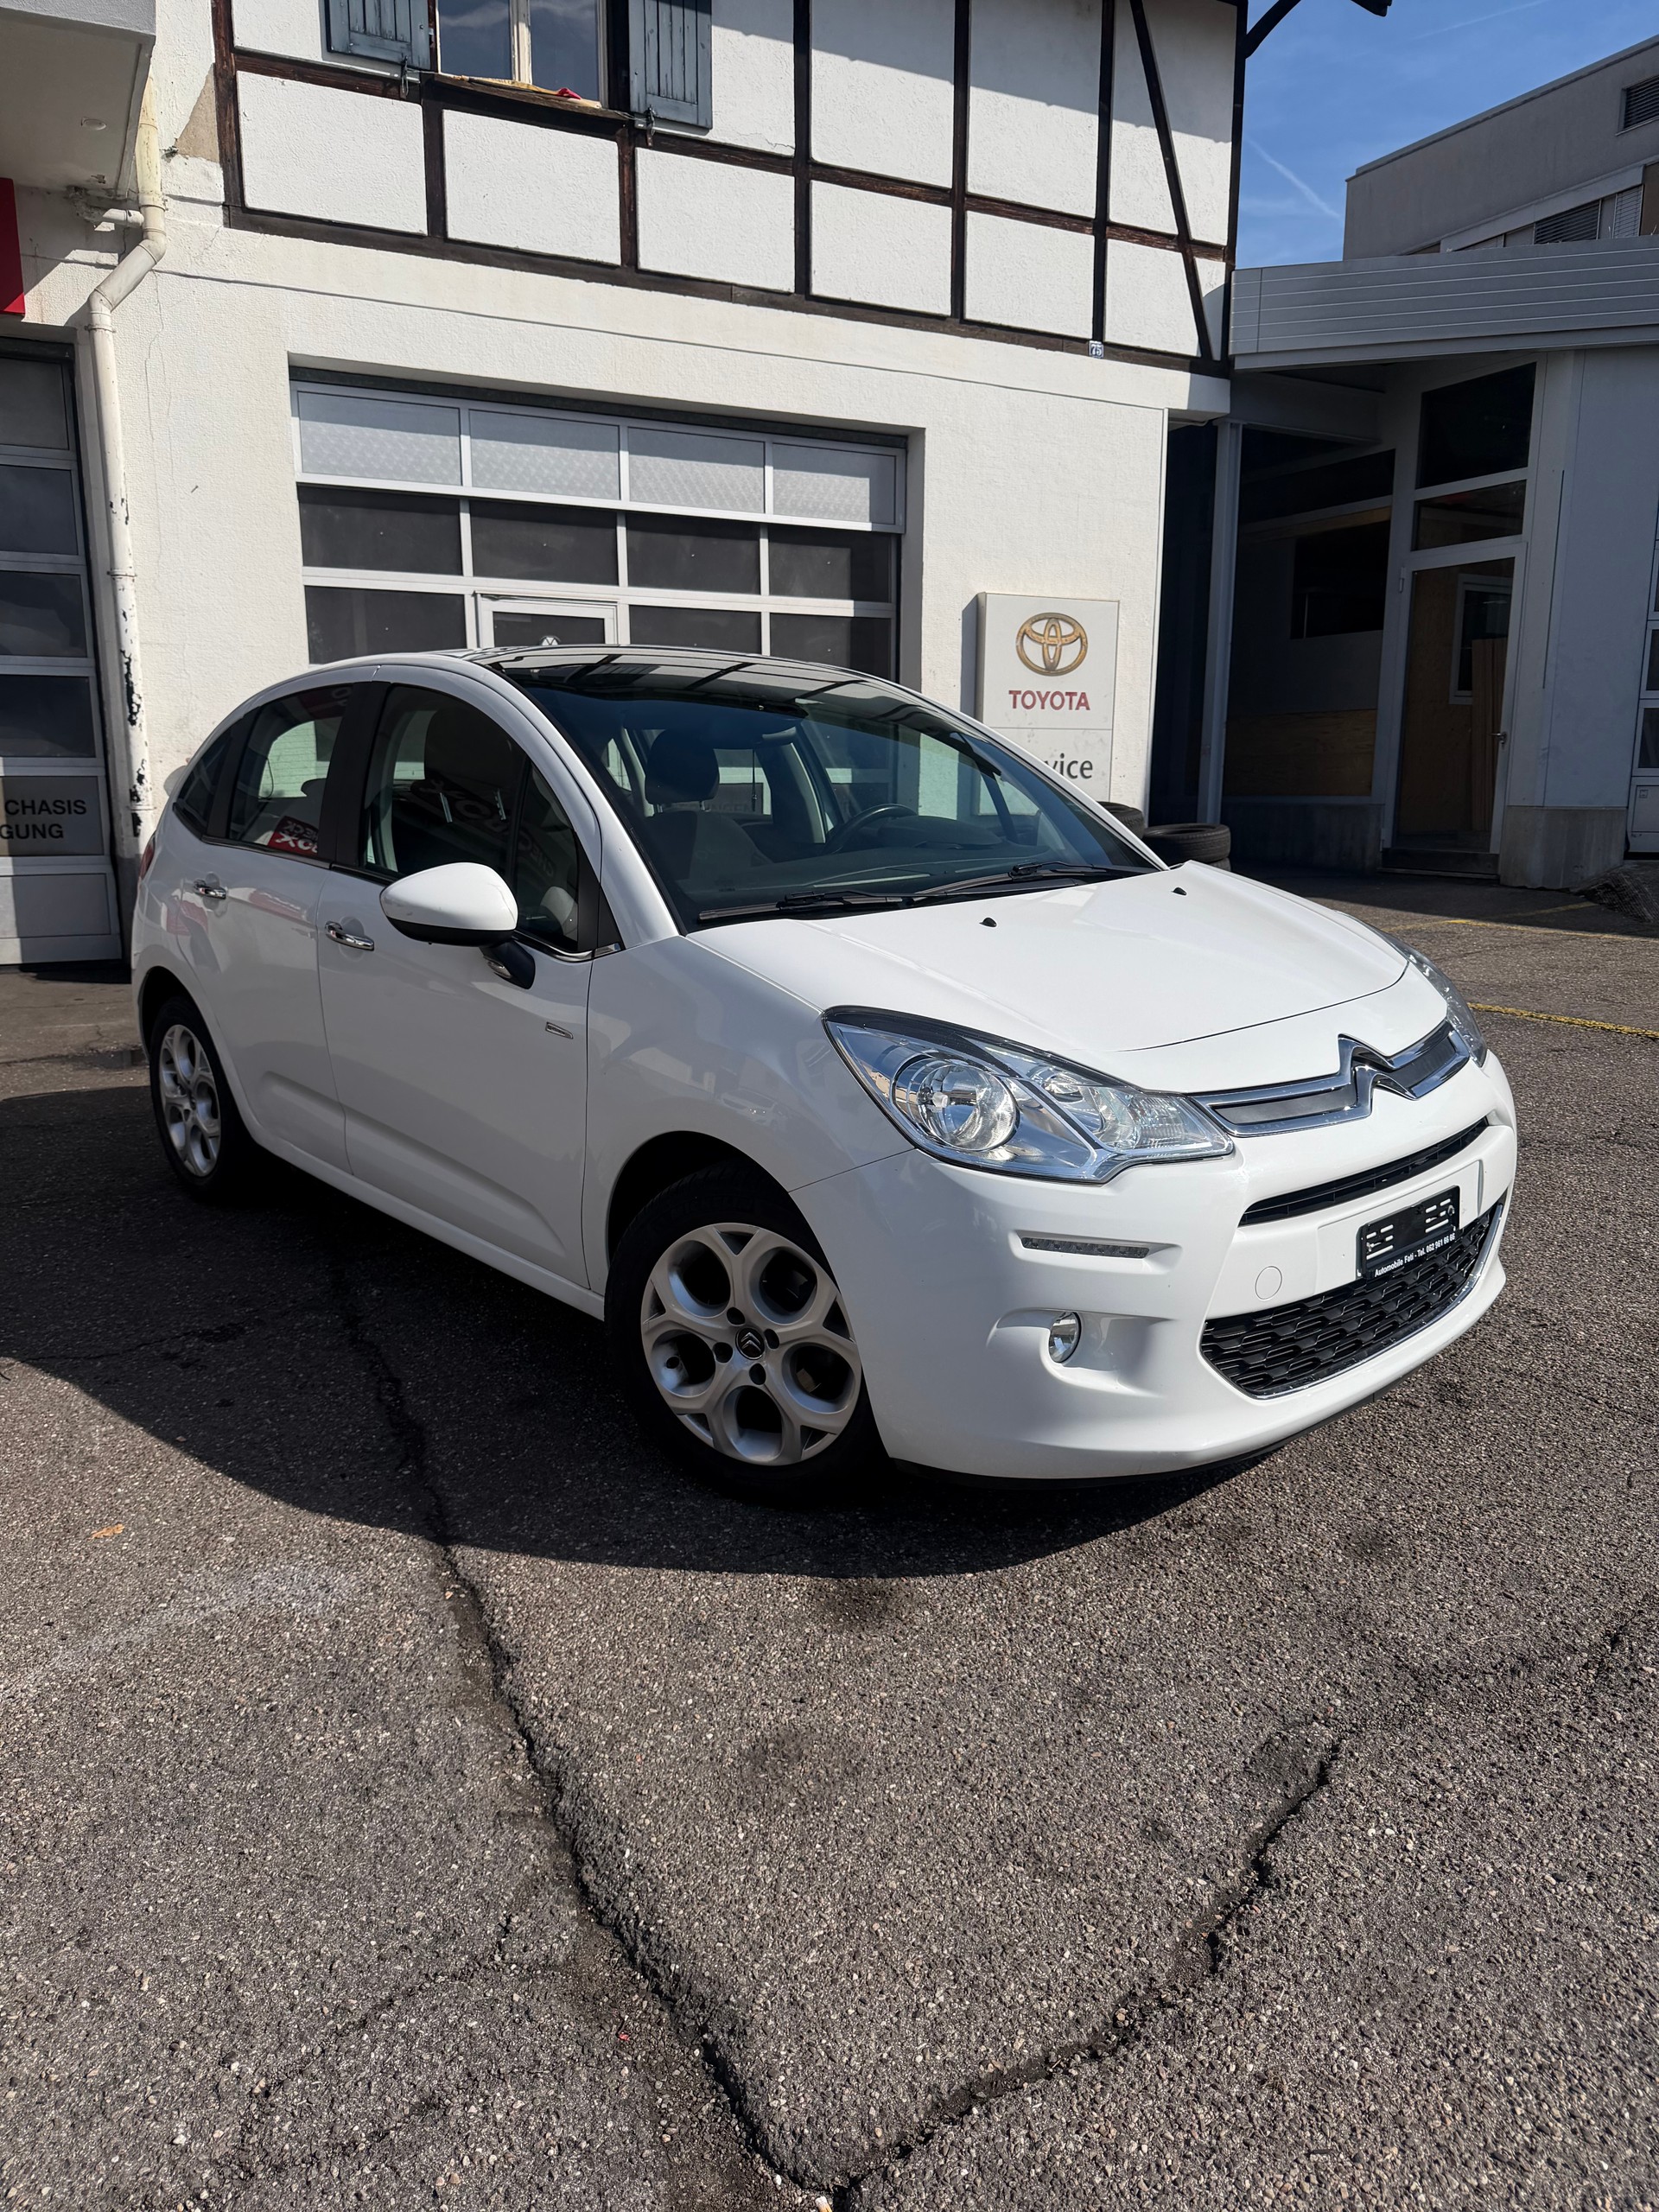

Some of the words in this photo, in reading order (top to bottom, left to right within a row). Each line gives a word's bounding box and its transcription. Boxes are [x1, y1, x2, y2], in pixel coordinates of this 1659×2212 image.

[1008, 690, 1090, 710] TOYOTA
[4, 799, 87, 815] CHASIS
[1375, 1259, 1403, 1277] Automobile
